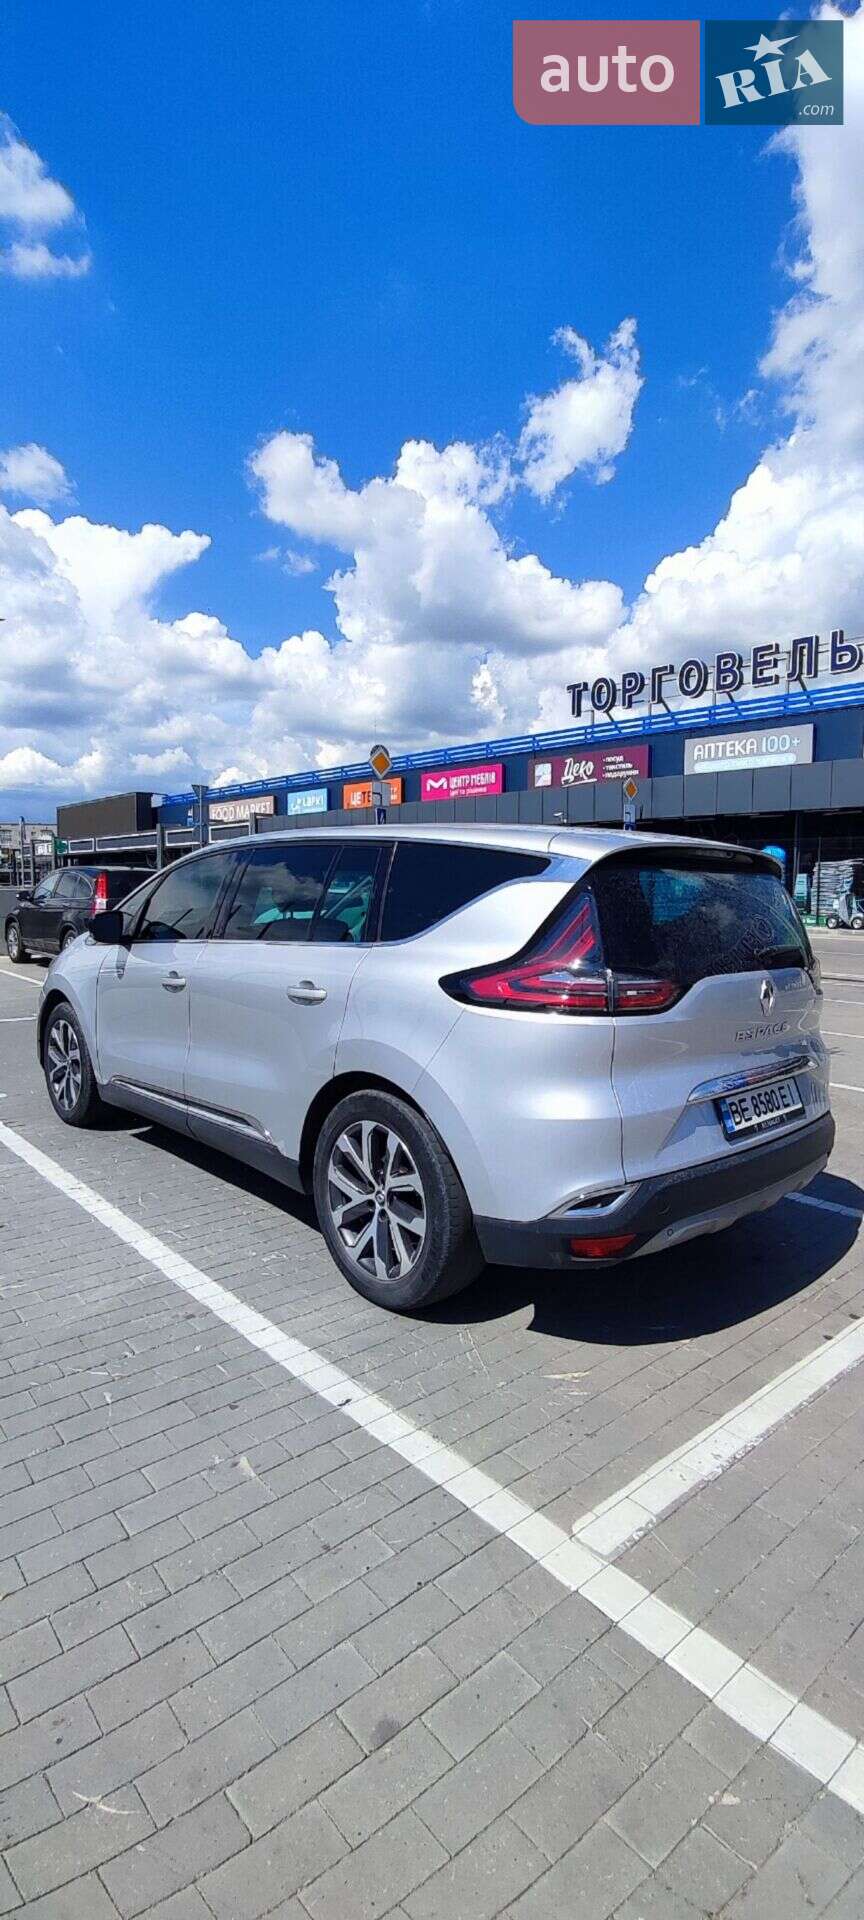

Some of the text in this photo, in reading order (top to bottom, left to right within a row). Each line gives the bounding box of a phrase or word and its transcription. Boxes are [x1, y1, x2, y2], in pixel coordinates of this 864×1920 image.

[566, 629, 864, 717] ТОРГОВЕЛЬ
[694, 734, 801, 761] АПТЕКА 100+
[449, 774, 470, 789] ЦЕНТР
[561, 757, 595, 785] Деко
[735, 1021, 790, 1041] ESPACE
[728, 1098, 752, 1126] BE
[751, 1089, 780, 1118] 8580
[778, 1084, 795, 1108] EI
